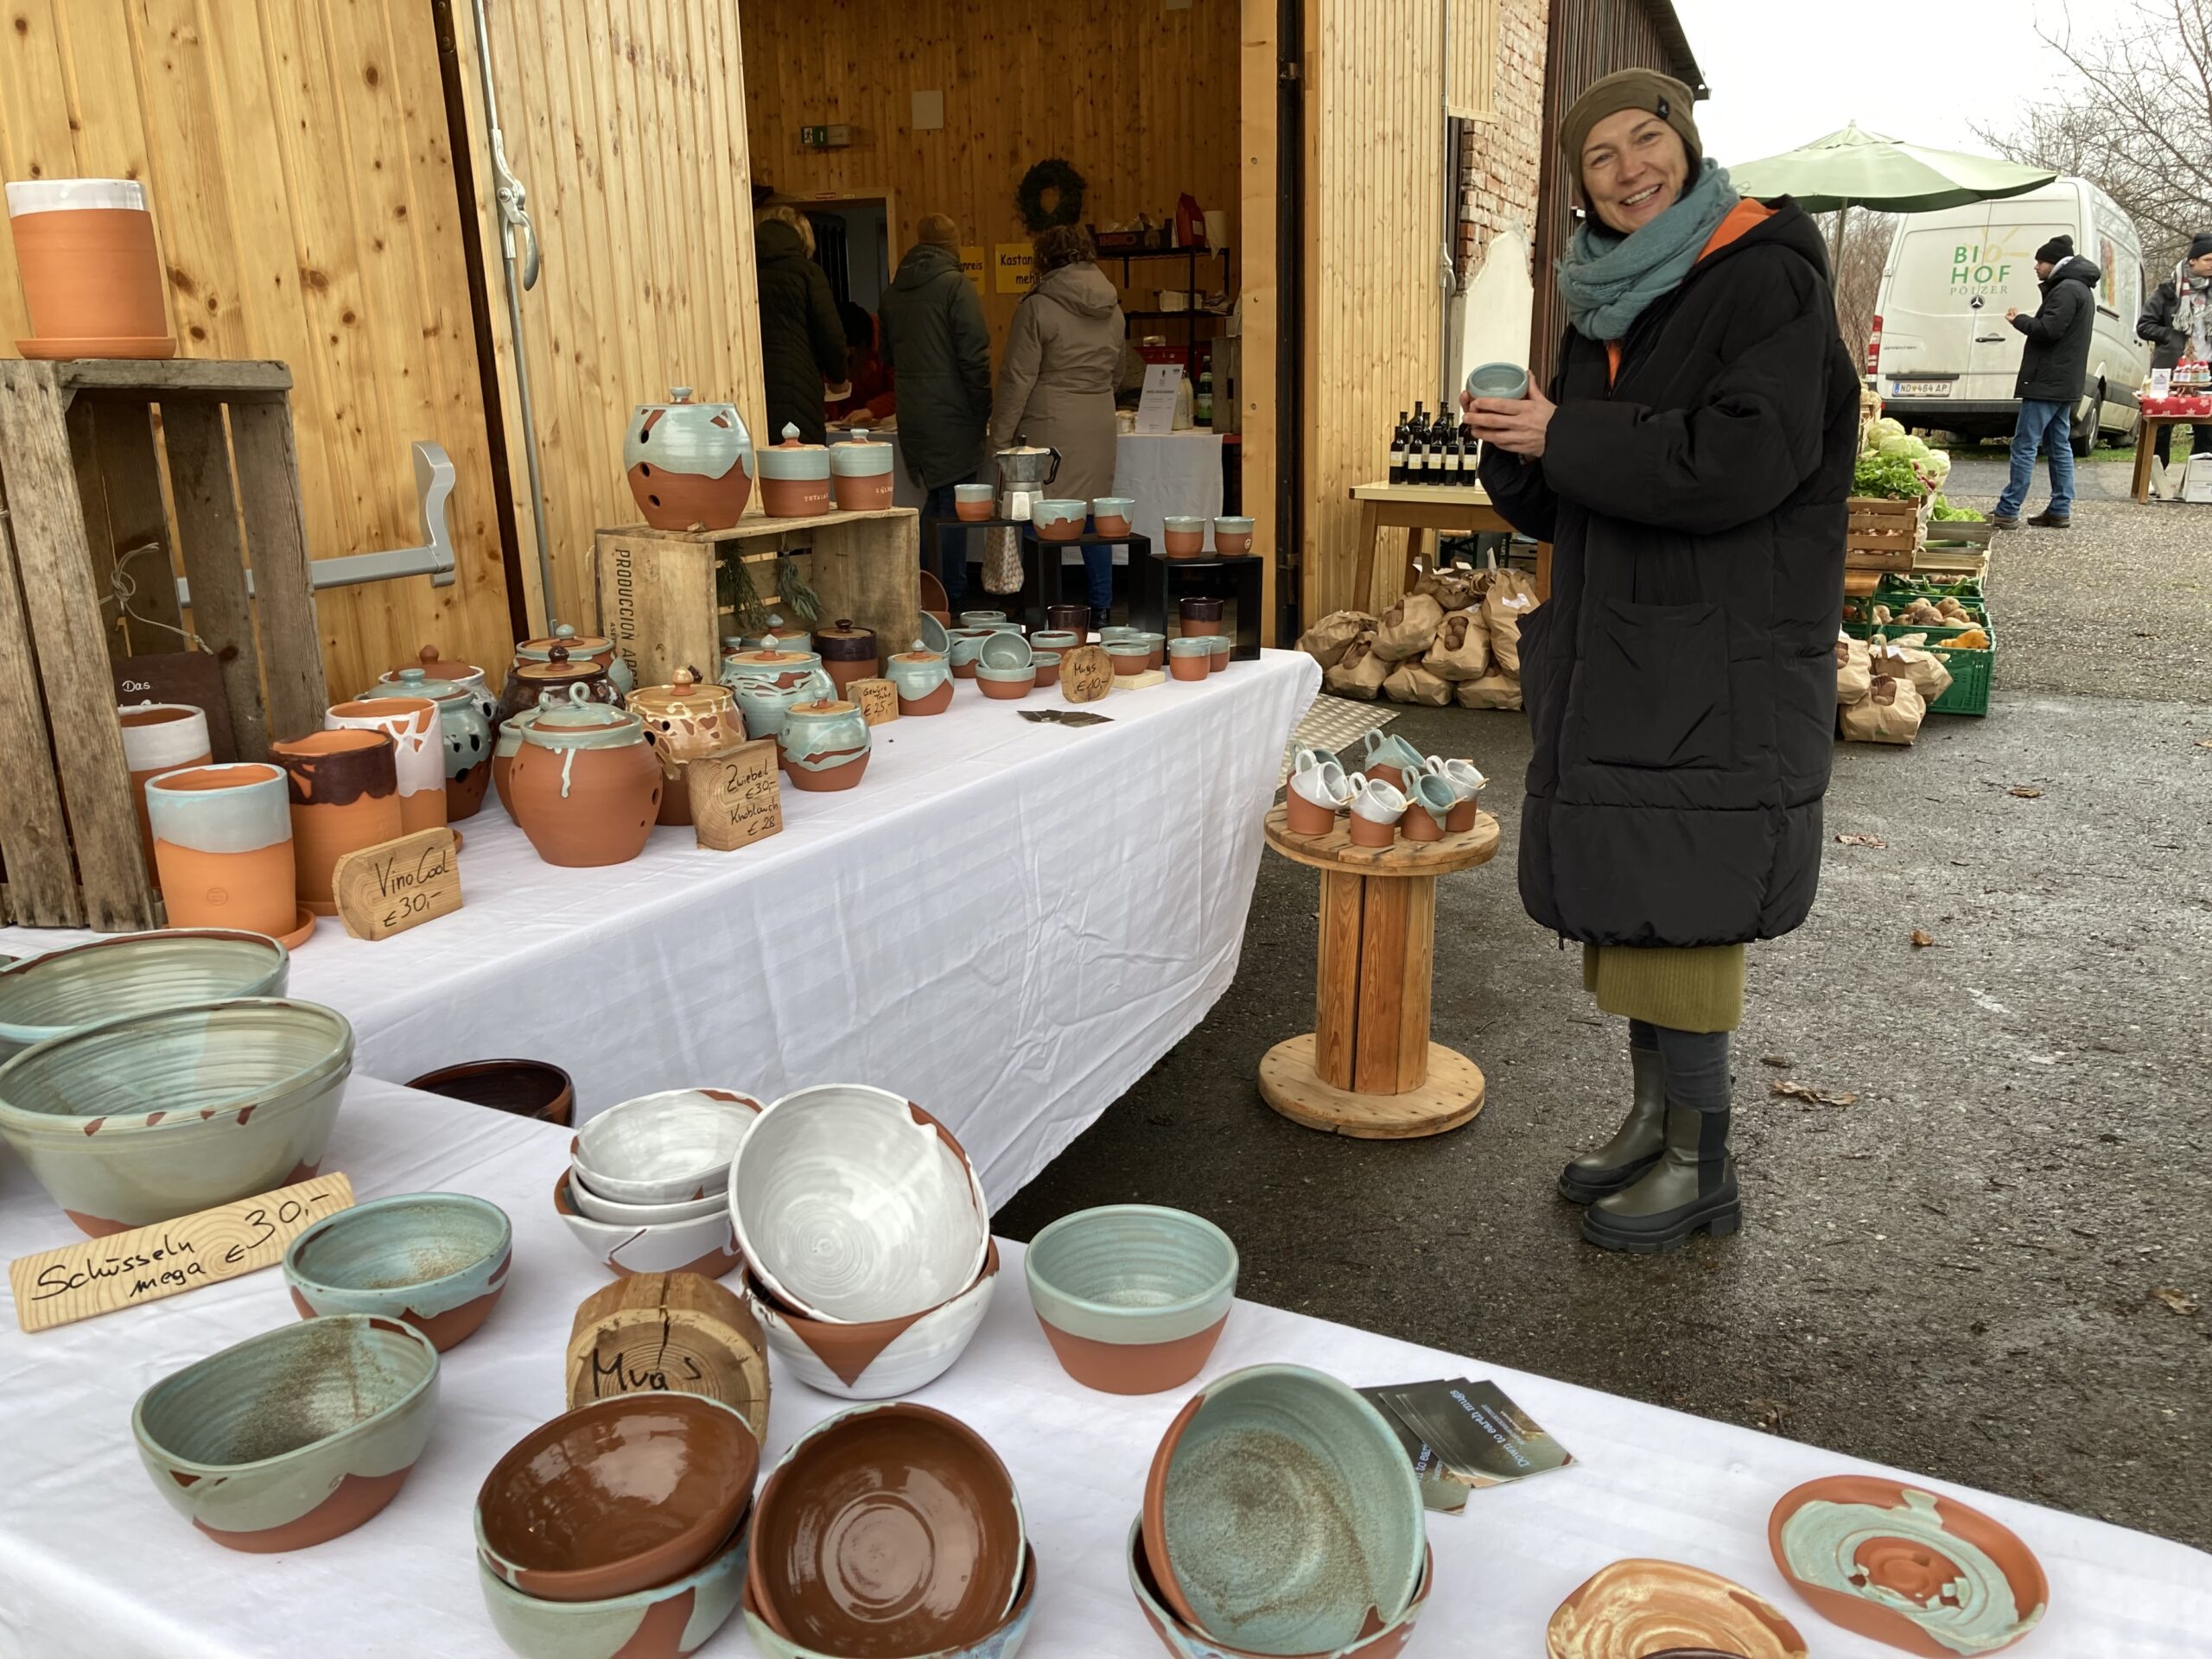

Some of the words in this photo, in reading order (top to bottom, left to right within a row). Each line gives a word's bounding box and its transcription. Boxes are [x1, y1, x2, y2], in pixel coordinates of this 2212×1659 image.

[1951, 265, 2012, 284] HOF
[1901, 384, 1912, 392] ND
[1917, 384, 1933, 392] 464
[615, 548, 635, 641] PRODUCCION
[1073, 663, 1096, 677] Mugs
[122, 680, 151, 692] Das
[726, 757, 769, 792] Zwiebel
[730, 795, 779, 826] Knoblauch
[374, 856, 413, 897] Vino
[416, 847, 449, 884] Cool
[130, 1262, 207, 1298] mega
[1450, 1389, 1475, 1412] mugs
[1471, 1411, 1497, 1434] earth
[1493, 1433, 1506, 1444] to
[1503, 1443, 1530, 1467] Down
